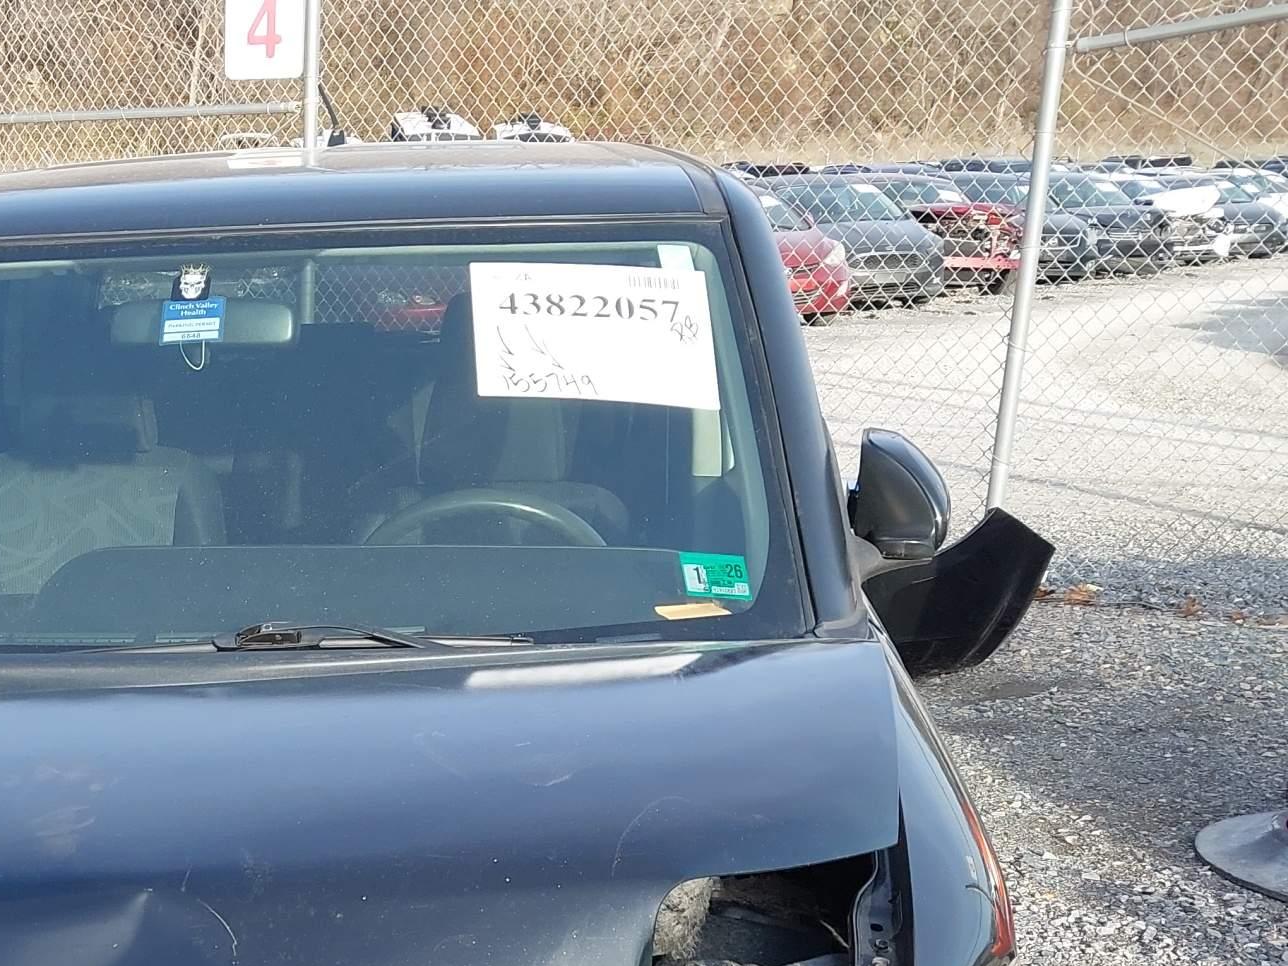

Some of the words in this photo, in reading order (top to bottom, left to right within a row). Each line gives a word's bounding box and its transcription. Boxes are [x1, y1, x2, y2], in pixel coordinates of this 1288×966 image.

[247, 0, 282, 58] 4
[169, 302, 194, 310] Clinch
[195, 301, 218, 309] Valley
[499, 293, 680, 322] 43822057
[692, 566, 702, 584] 1
[725, 564, 744, 579] 26
